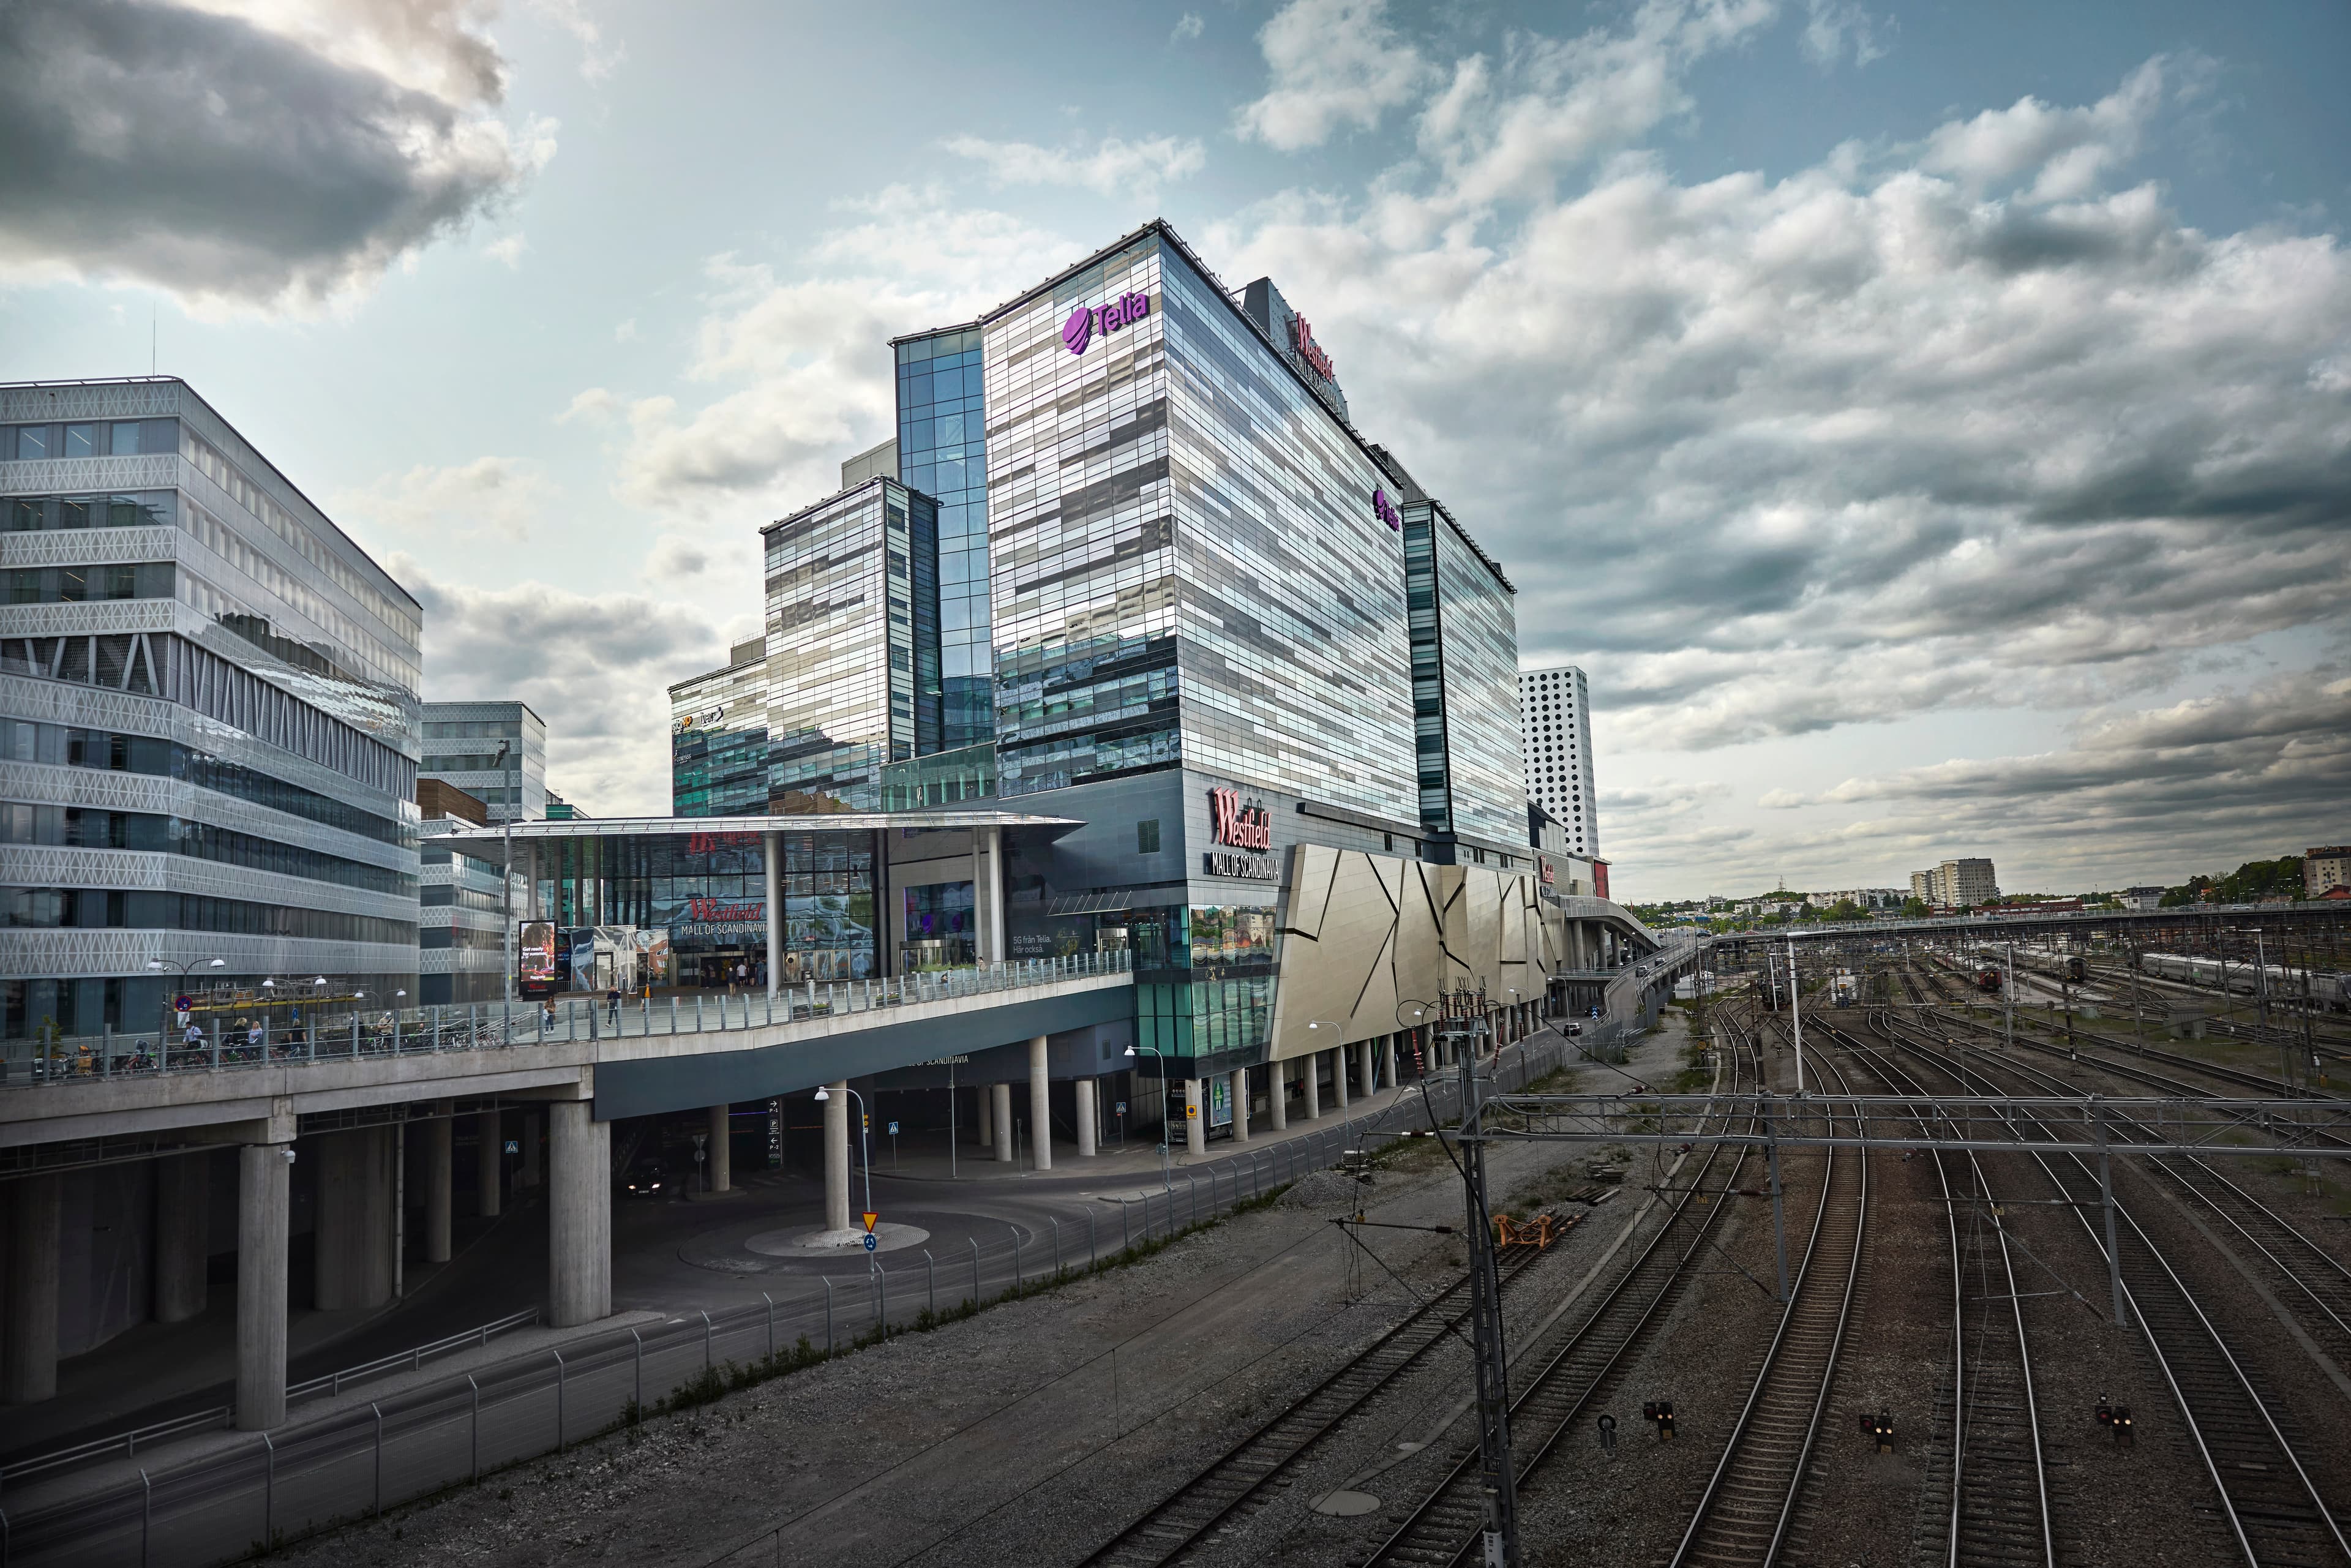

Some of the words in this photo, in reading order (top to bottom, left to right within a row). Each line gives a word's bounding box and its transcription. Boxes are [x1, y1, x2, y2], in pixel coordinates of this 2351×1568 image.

[1092, 291, 1150, 336] Telia
[1295, 312, 1333, 385] Westfield
[1295, 351, 1309, 378] MALL
[1308, 364, 1314, 383] OF
[1384, 498, 1400, 532] Telia
[1213, 786, 1272, 850] Westfield
[1212, 852, 1231, 876] MALL
[1231, 854, 1239, 877] OF
[1240, 856, 1280, 880] SCANDINAVIA
[689, 898, 764, 922] Westfield
[681, 925, 703, 936] MALL
[705, 925, 715, 935] OF
[1023, 935, 1035, 943] från
[1036, 934, 1051, 943] Telia.
[1013, 945, 1024, 954] Här
[1025, 944, 1044, 953] också.
